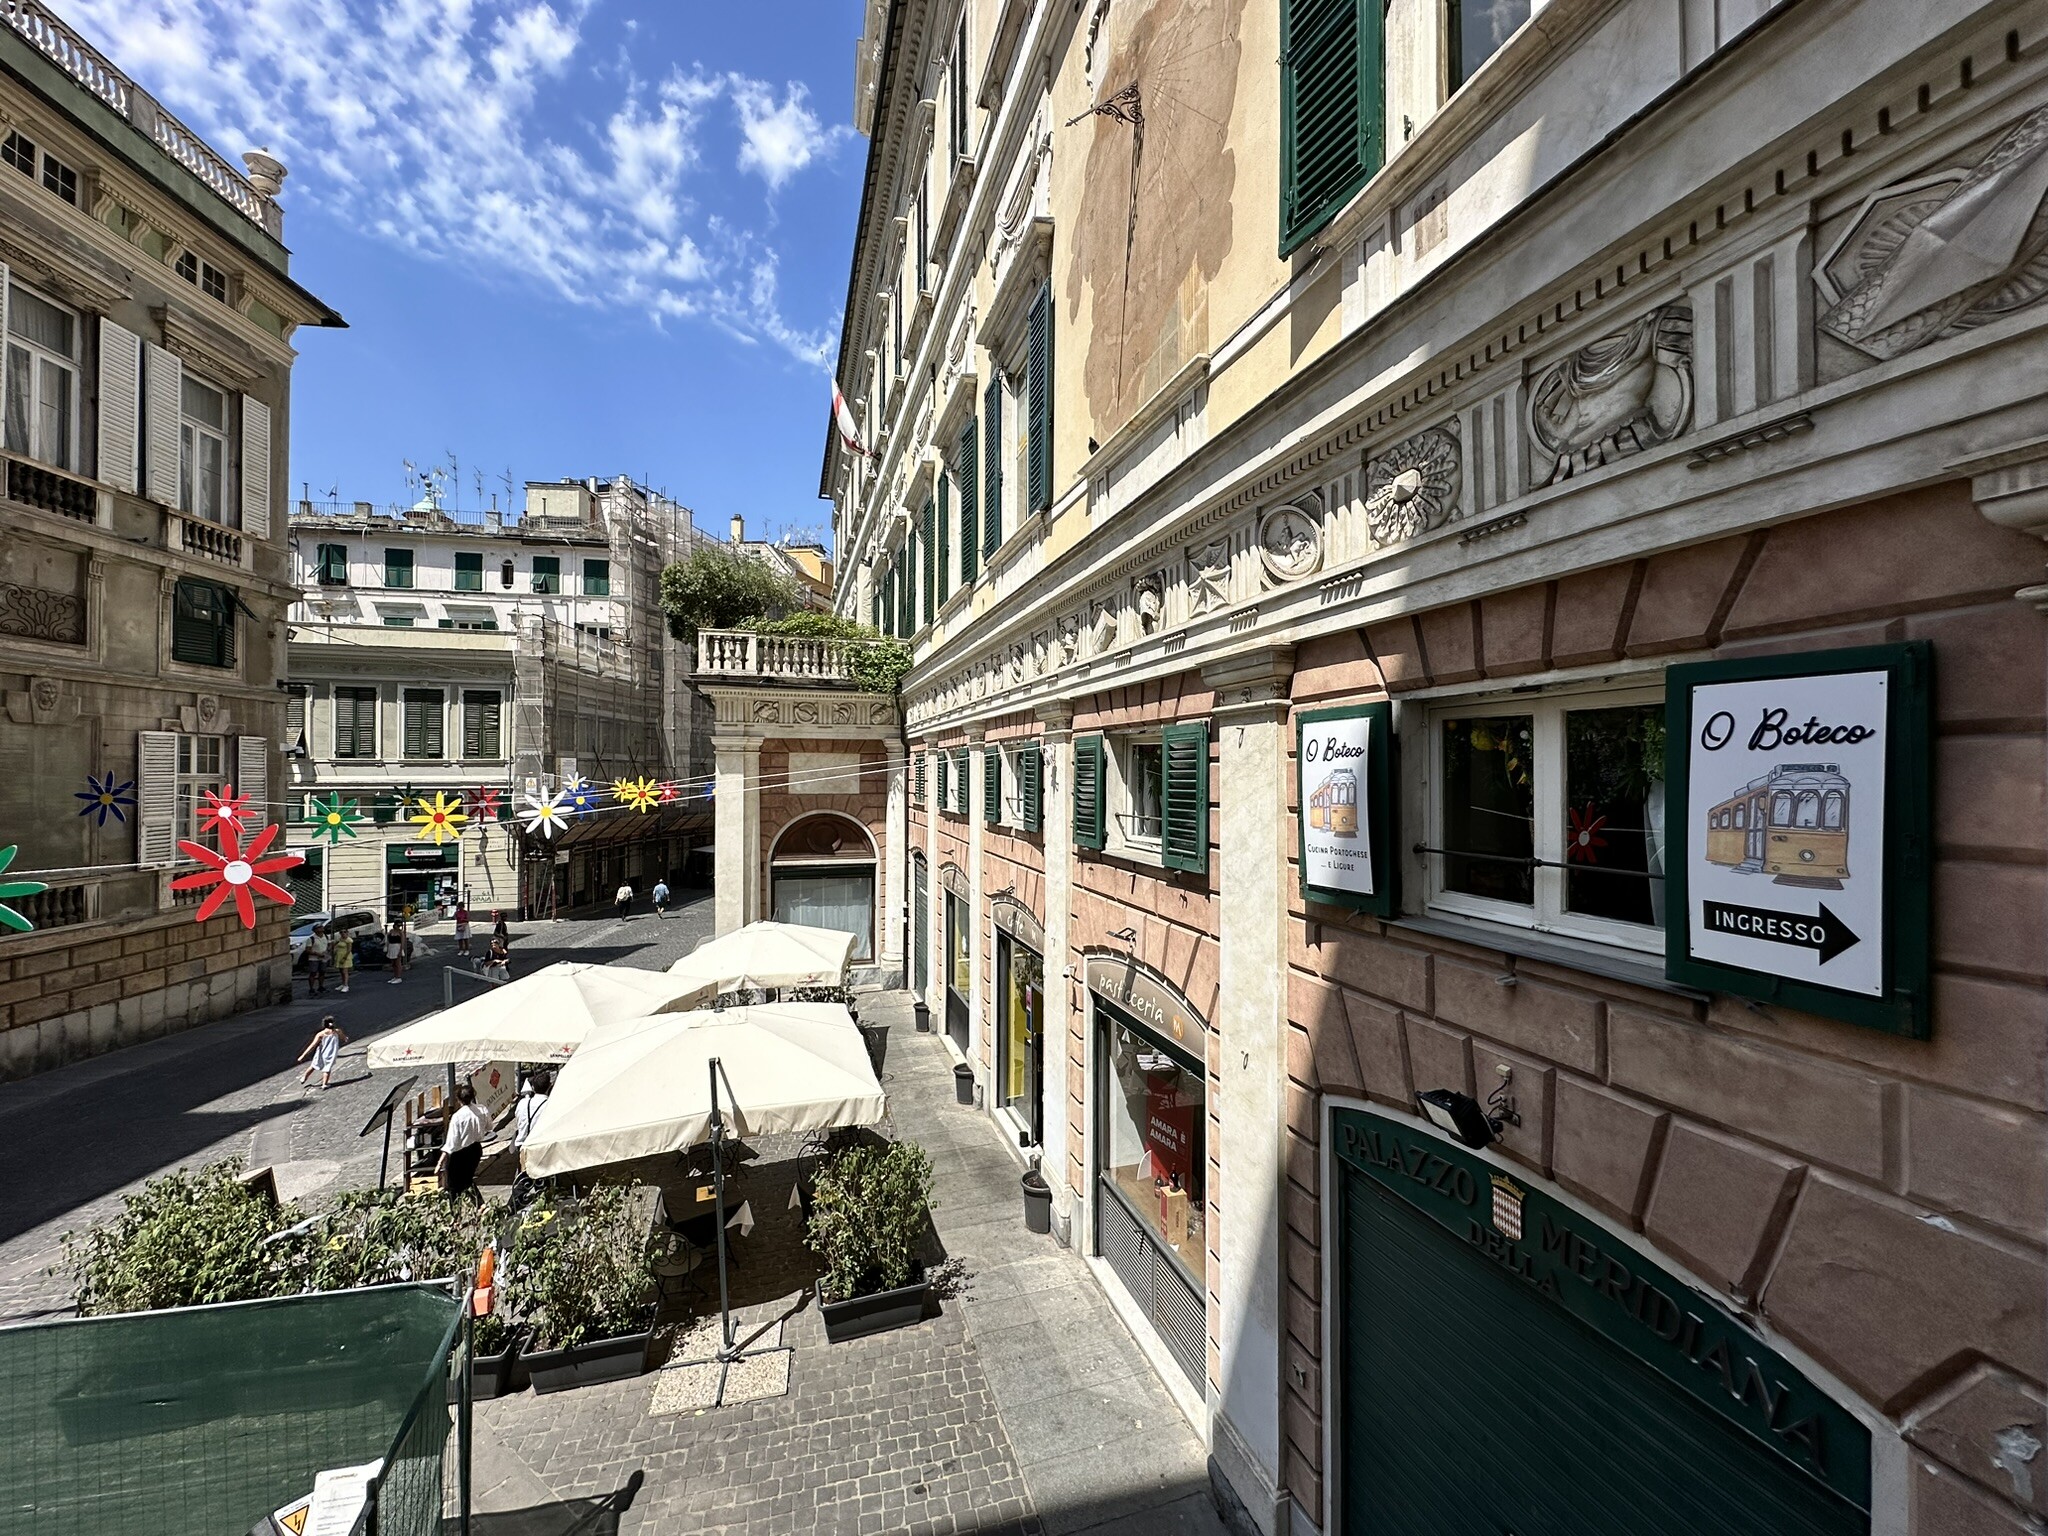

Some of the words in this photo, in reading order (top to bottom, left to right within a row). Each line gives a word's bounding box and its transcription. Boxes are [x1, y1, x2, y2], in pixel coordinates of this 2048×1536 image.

[1700, 710, 1736, 751] O
[1747, 707, 1877, 751] Boteco
[1305, 738, 1319, 763] O
[1322, 736, 1365, 762] Boteco
[1714, 908, 1827, 945] INGRESSO
[1149, 1128, 1177, 1152] AMARA
[1150, 1116, 1178, 1139] AMARA
[1341, 1122, 1477, 1206] PALAZZO
[1468, 1217, 1564, 1304] DELLA
[1539, 1211, 1828, 1476] MERIDIANA
